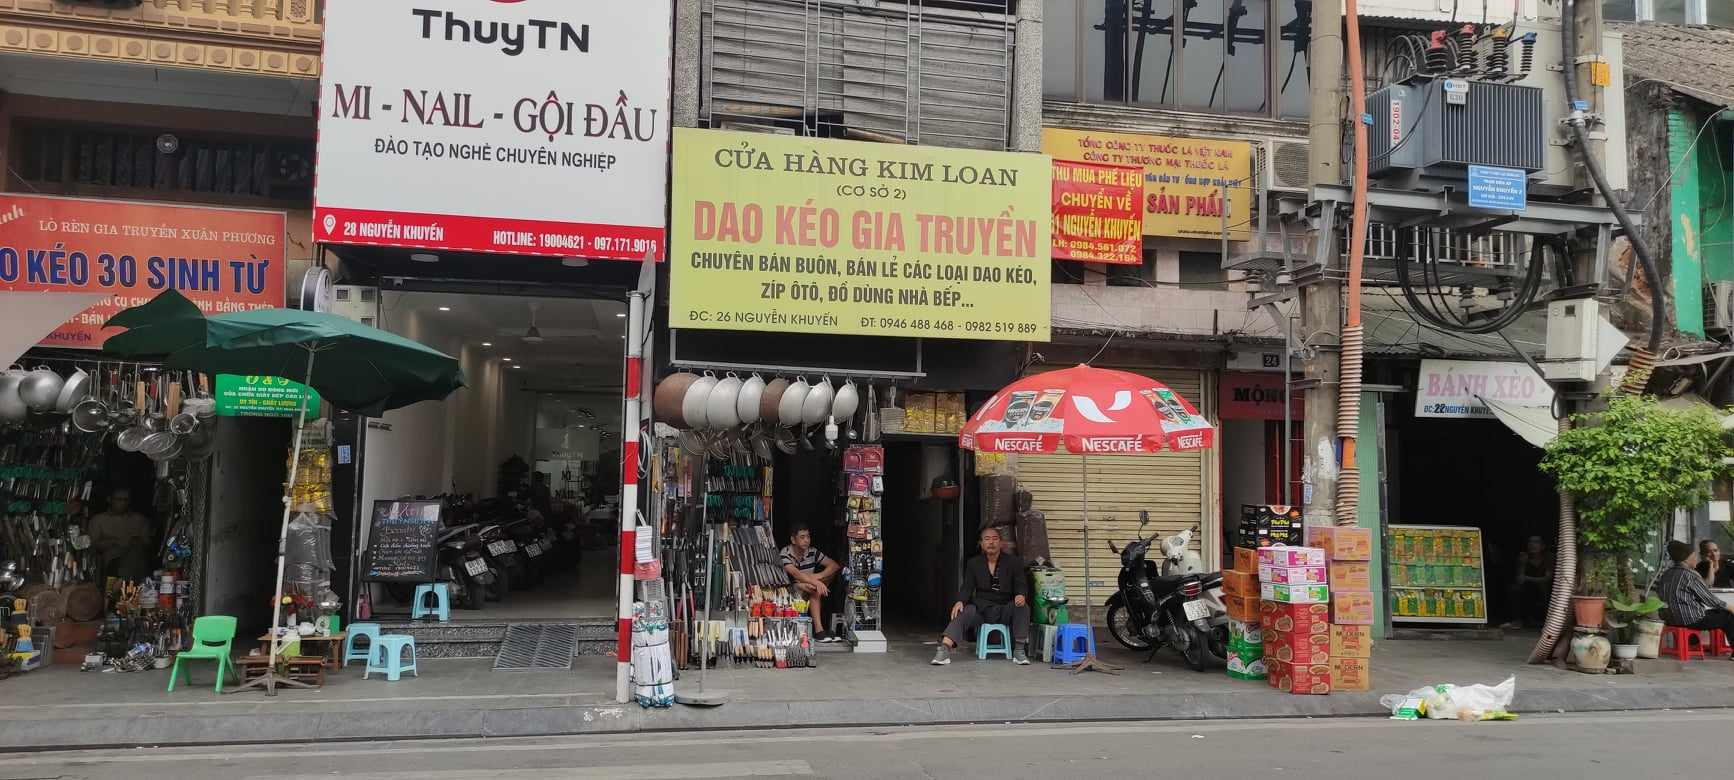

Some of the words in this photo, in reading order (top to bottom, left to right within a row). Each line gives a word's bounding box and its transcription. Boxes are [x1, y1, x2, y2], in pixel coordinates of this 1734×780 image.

[413, 9, 590, 56] ThuyTN
[332, 83, 372, 120] MI
[401, 88, 484, 129] NAIL
[514, 90, 574, 142] GỘI
[584, 89, 657, 142] ĐẦU
[374, 137, 408, 155] ĐÀO
[413, 141, 445, 161] TẠO
[496, 146, 557, 166] CHUYÊN
[561, 151, 616, 173] NGHIỆP
[714, 141, 774, 170] CỬA
[783, 150, 869, 178] HÀNG
[876, 160, 935, 182] KIM
[942, 165, 1018, 187] LOAN
[1052, 166, 1070, 183] THU
[1072, 168, 1095, 185] MUA
[1120, 169, 1142, 190] LIỆU
[836, 184, 866, 197] (CƠ
[869, 183, 890, 199] SỞ
[893, 187, 907, 200] 2)
[1146, 186, 1180, 215] SẢN
[40, 217, 58, 232] LÒ
[62, 218, 90, 233] RÈN
[94, 224, 118, 235] GIA
[181, 227, 219, 241] XUÂN
[344, 222, 356, 236] 28
[359, 220, 401, 239] NGUYỄN
[404, 223, 444, 241] KHUYẾN
[493, 231, 536, 247] HOTLINE:
[539, 233, 585, 249] 19004621
[694, 200, 763, 243] DAO
[775, 198, 840, 248] KÉO
[851, 208, 905, 253] GIA
[916, 205, 1037, 258] TRUYỀN
[27, 242, 89, 287] KÉO
[97, 252, 137, 288] 30
[146, 256, 221, 292] SINH
[229, 253, 270, 295] TỪ
[690, 251, 754, 272] CHUYÊN
[759, 253, 791, 274] BÁN
[795, 255, 842, 277] BUÔN,
[846, 257, 877, 278] BÁN
[881, 255, 899, 279] LẺ
[903, 258, 932, 280] CÁC
[936, 263, 969, 285] LOẠI
[973, 266, 1001, 283] DAO
[1005, 263, 1037, 286] KÉO,
[761, 279, 786, 299] ZÍP
[789, 281, 824, 303] ÔTÔ,
[828, 280, 849, 303] ĐỒ
[853, 284, 894, 305] DÙNG
[898, 287, 929, 306] NHÀ
[689, 310, 712, 323] ĐC:
[716, 311, 731, 323] 26
[735, 308, 787, 326] NGUYỄN
[790, 311, 839, 327] KHUYẾN
[860, 317, 877, 328] ĐT:
[880, 318, 907, 330] 0946
[910, 319, 931, 331] 488
[933, 320, 954, 331] 468
[965, 321, 992, 333] 0982
[994, 322, 1015, 334] 519
[1017, 323, 1037, 335] 889
[994, 434, 1043, 452] NESCAFÉ
[1082, 434, 1143, 452] NESCAFÉ
[1177, 432, 1204, 449] NESCAFÉ
